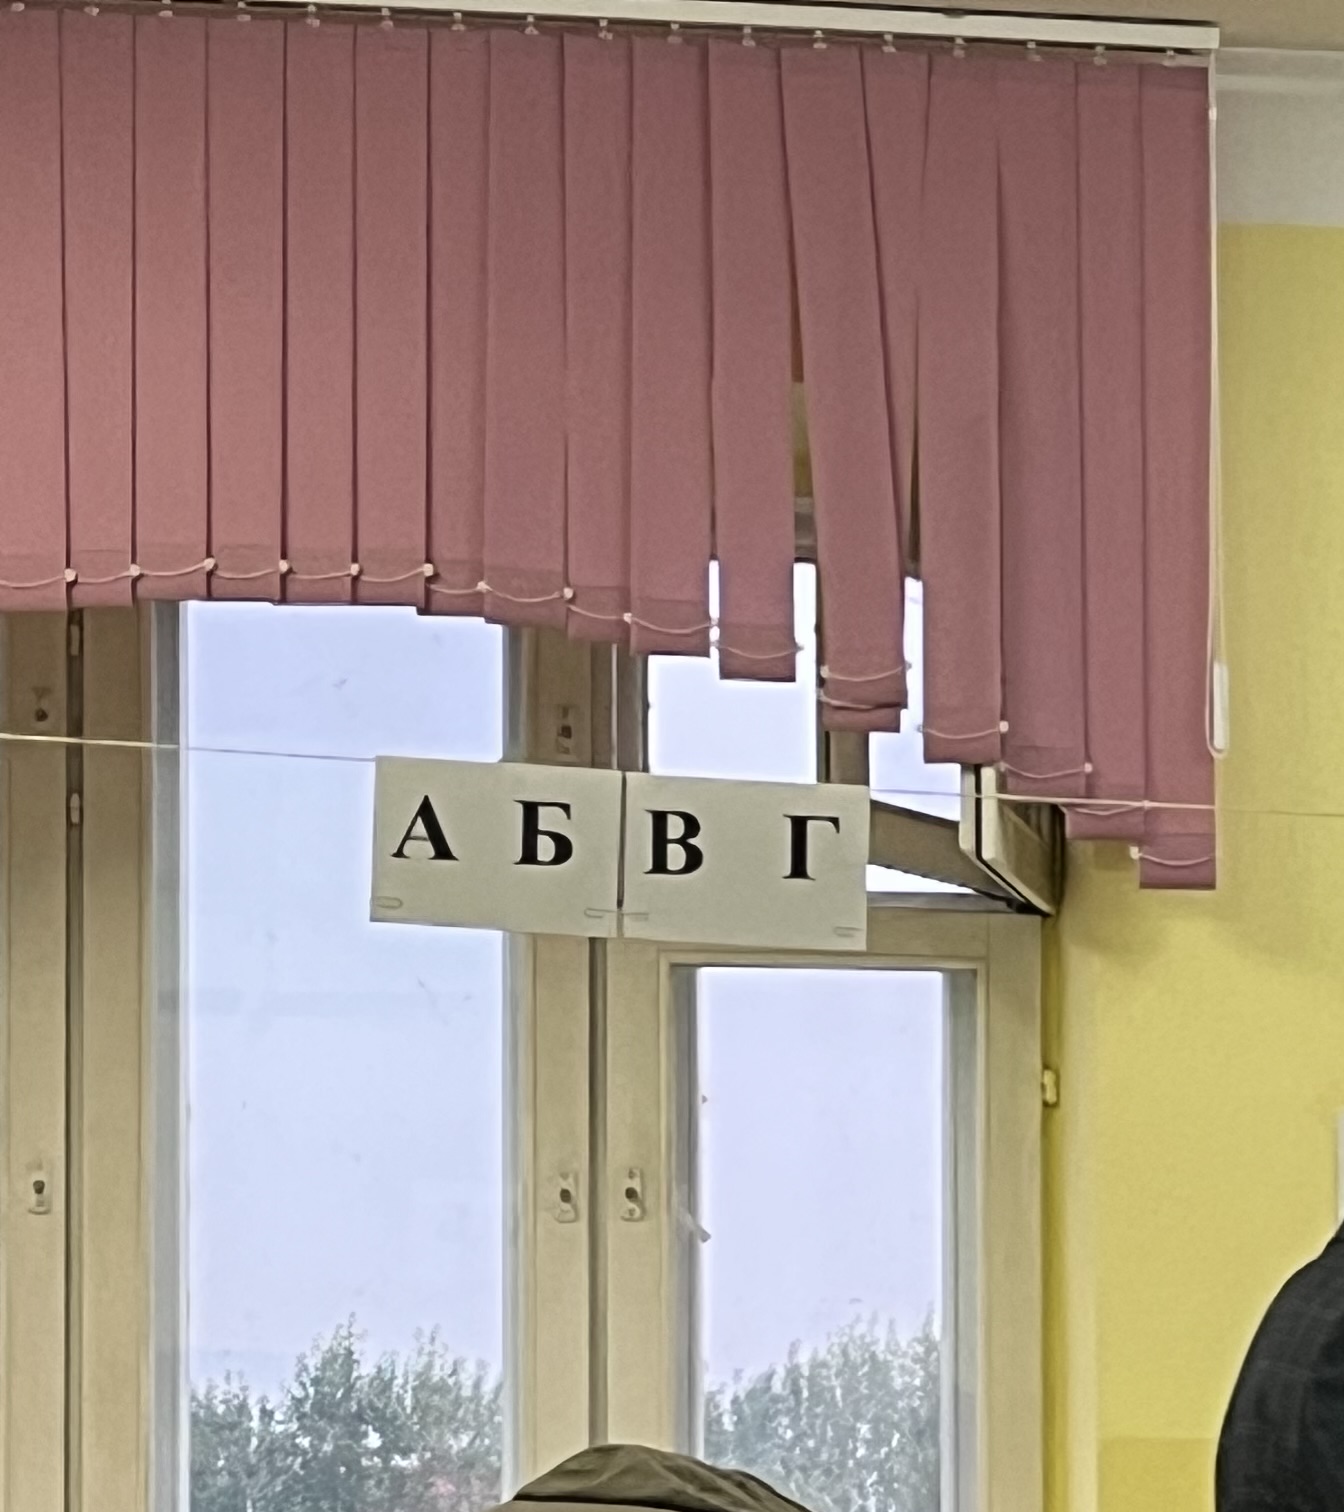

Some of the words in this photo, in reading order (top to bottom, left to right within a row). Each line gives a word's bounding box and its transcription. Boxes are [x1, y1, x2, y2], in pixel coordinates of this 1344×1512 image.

[391, 794, 459, 861] А
[513, 799, 573, 866] Б
[644, 809, 704, 876] В
[782, 814, 840, 881] Г
